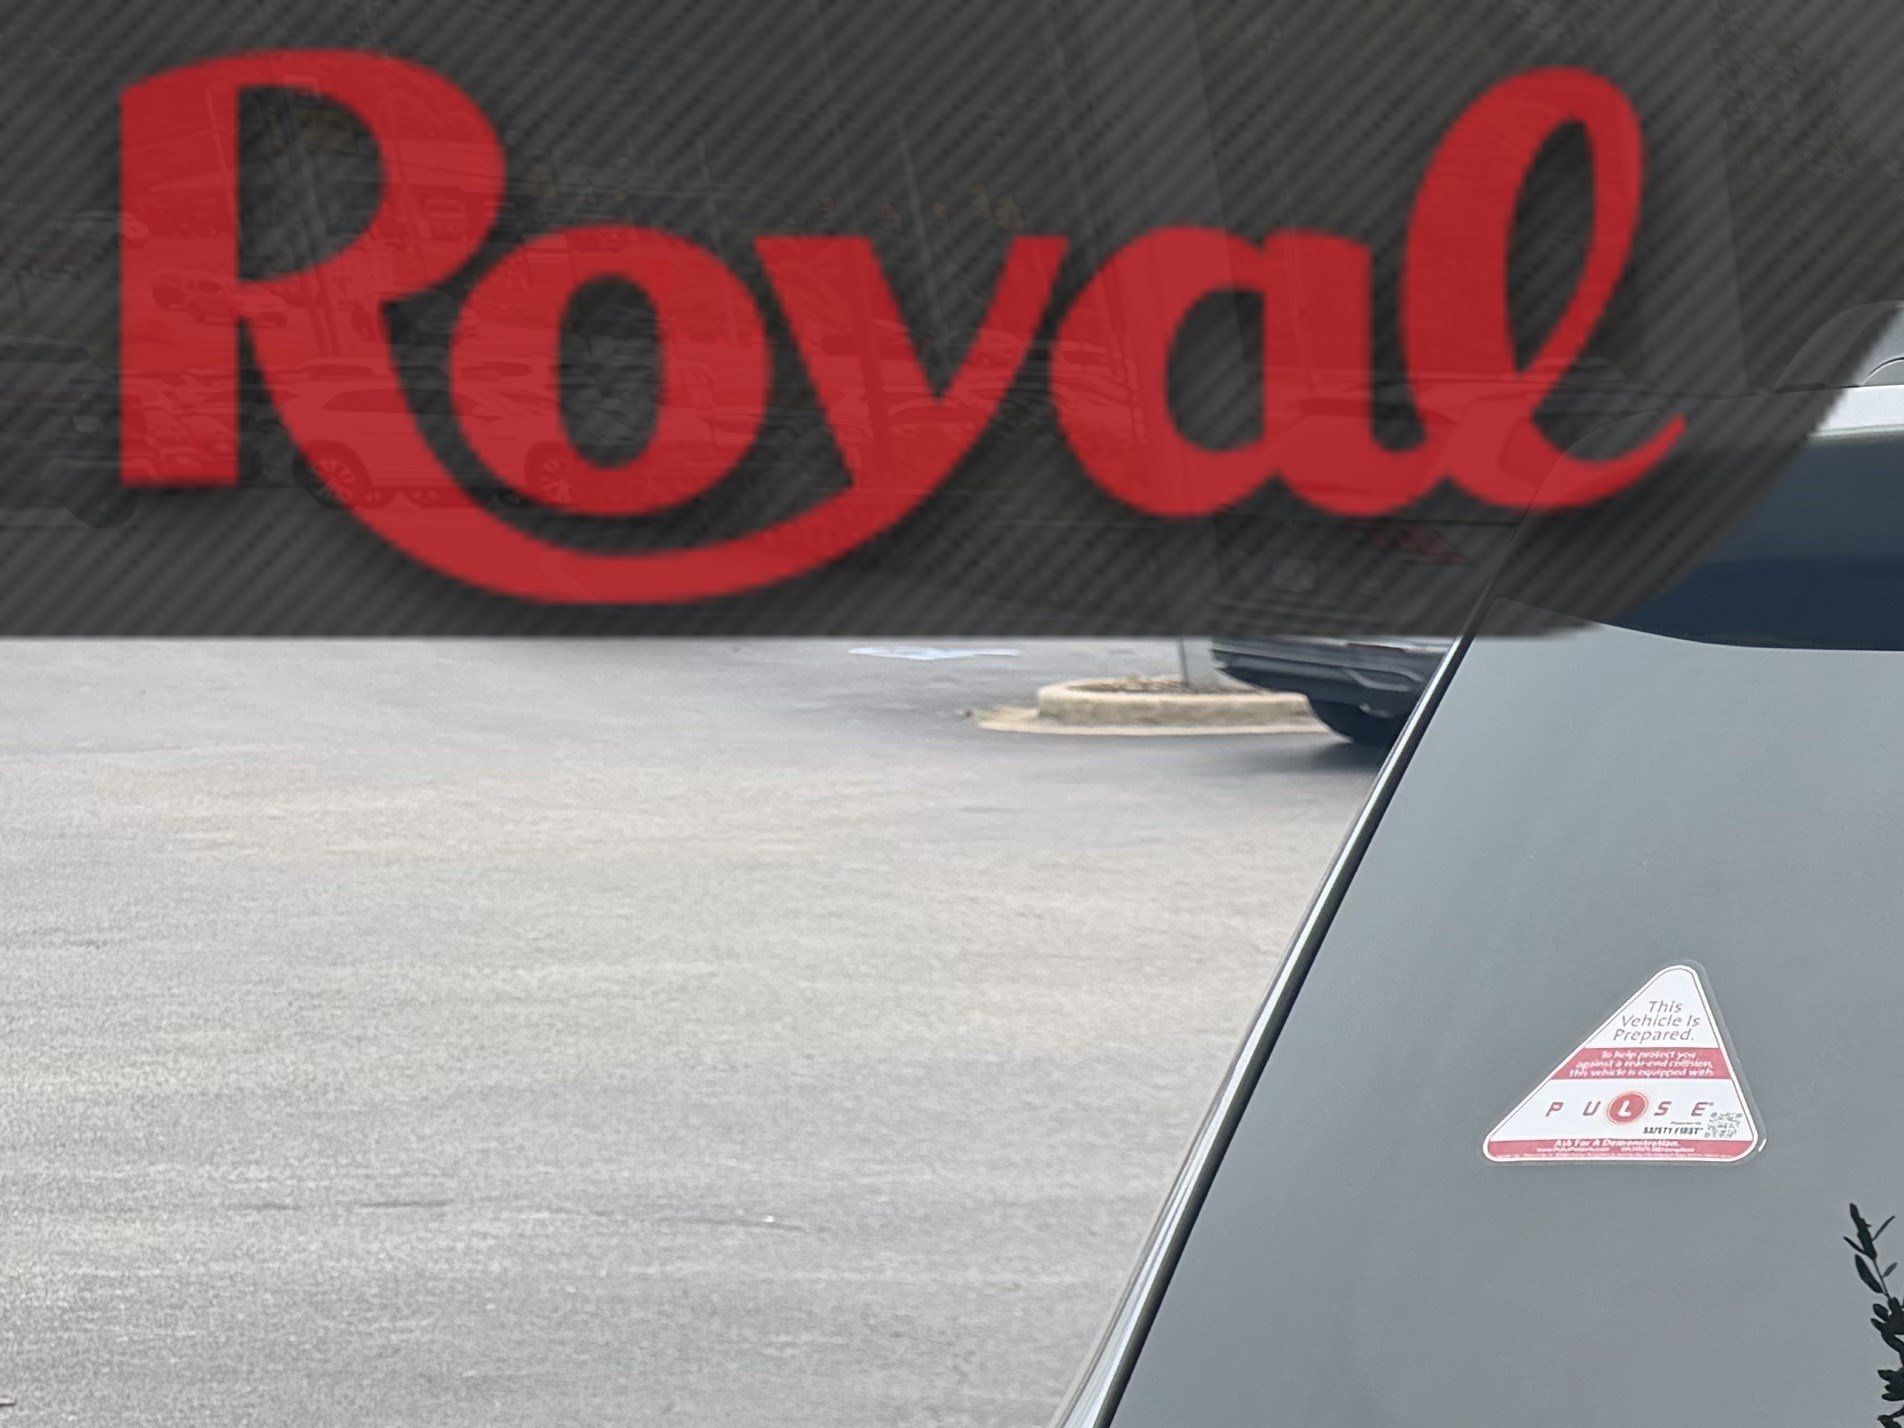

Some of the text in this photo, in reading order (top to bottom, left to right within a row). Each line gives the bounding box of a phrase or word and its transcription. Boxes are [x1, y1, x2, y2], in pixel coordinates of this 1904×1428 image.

[1648, 1000, 1682, 1013] This
[1622, 1014, 1682, 1027] Vehicle
[1612, 1028, 1695, 1044] Prepared.
